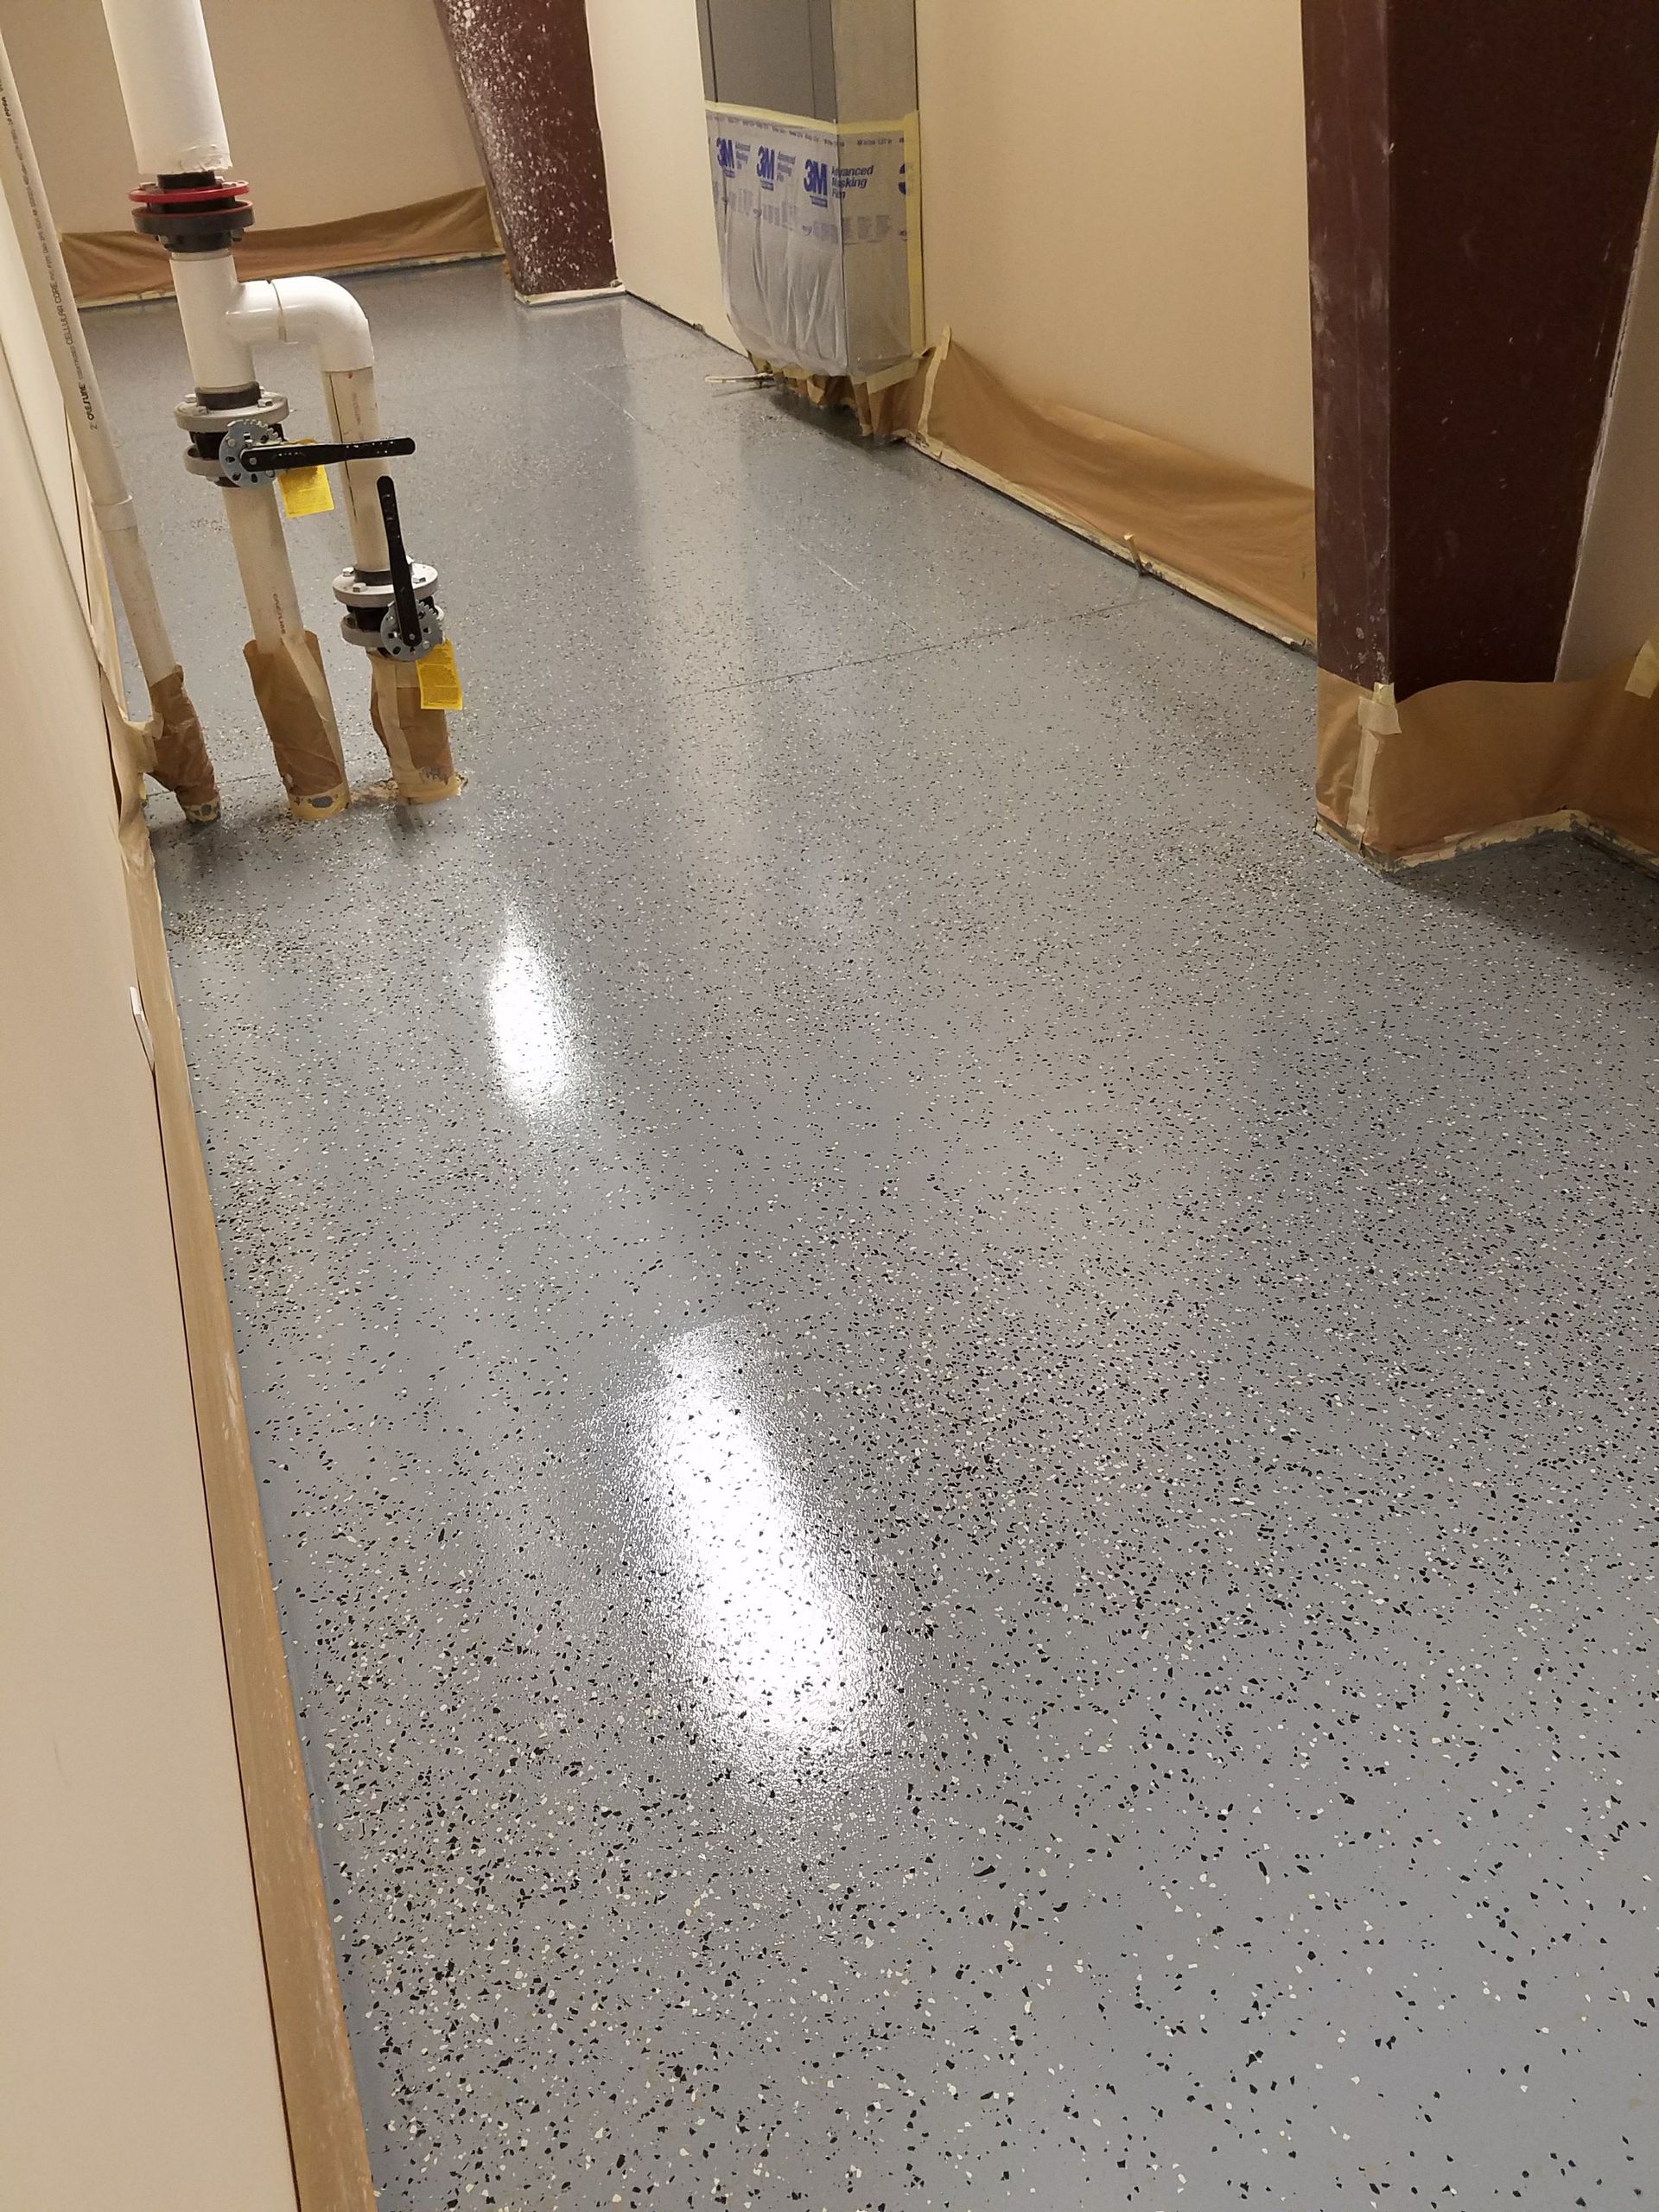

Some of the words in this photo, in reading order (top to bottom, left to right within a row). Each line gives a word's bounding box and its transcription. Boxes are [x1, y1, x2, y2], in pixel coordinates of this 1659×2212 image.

[716, 137, 734, 169] 3M
[757, 145, 775, 180] 3M
[804, 159, 828, 196] 3M
[50, 282, 62, 303] CORE
[57, 305, 73, 345] CELLULAR
